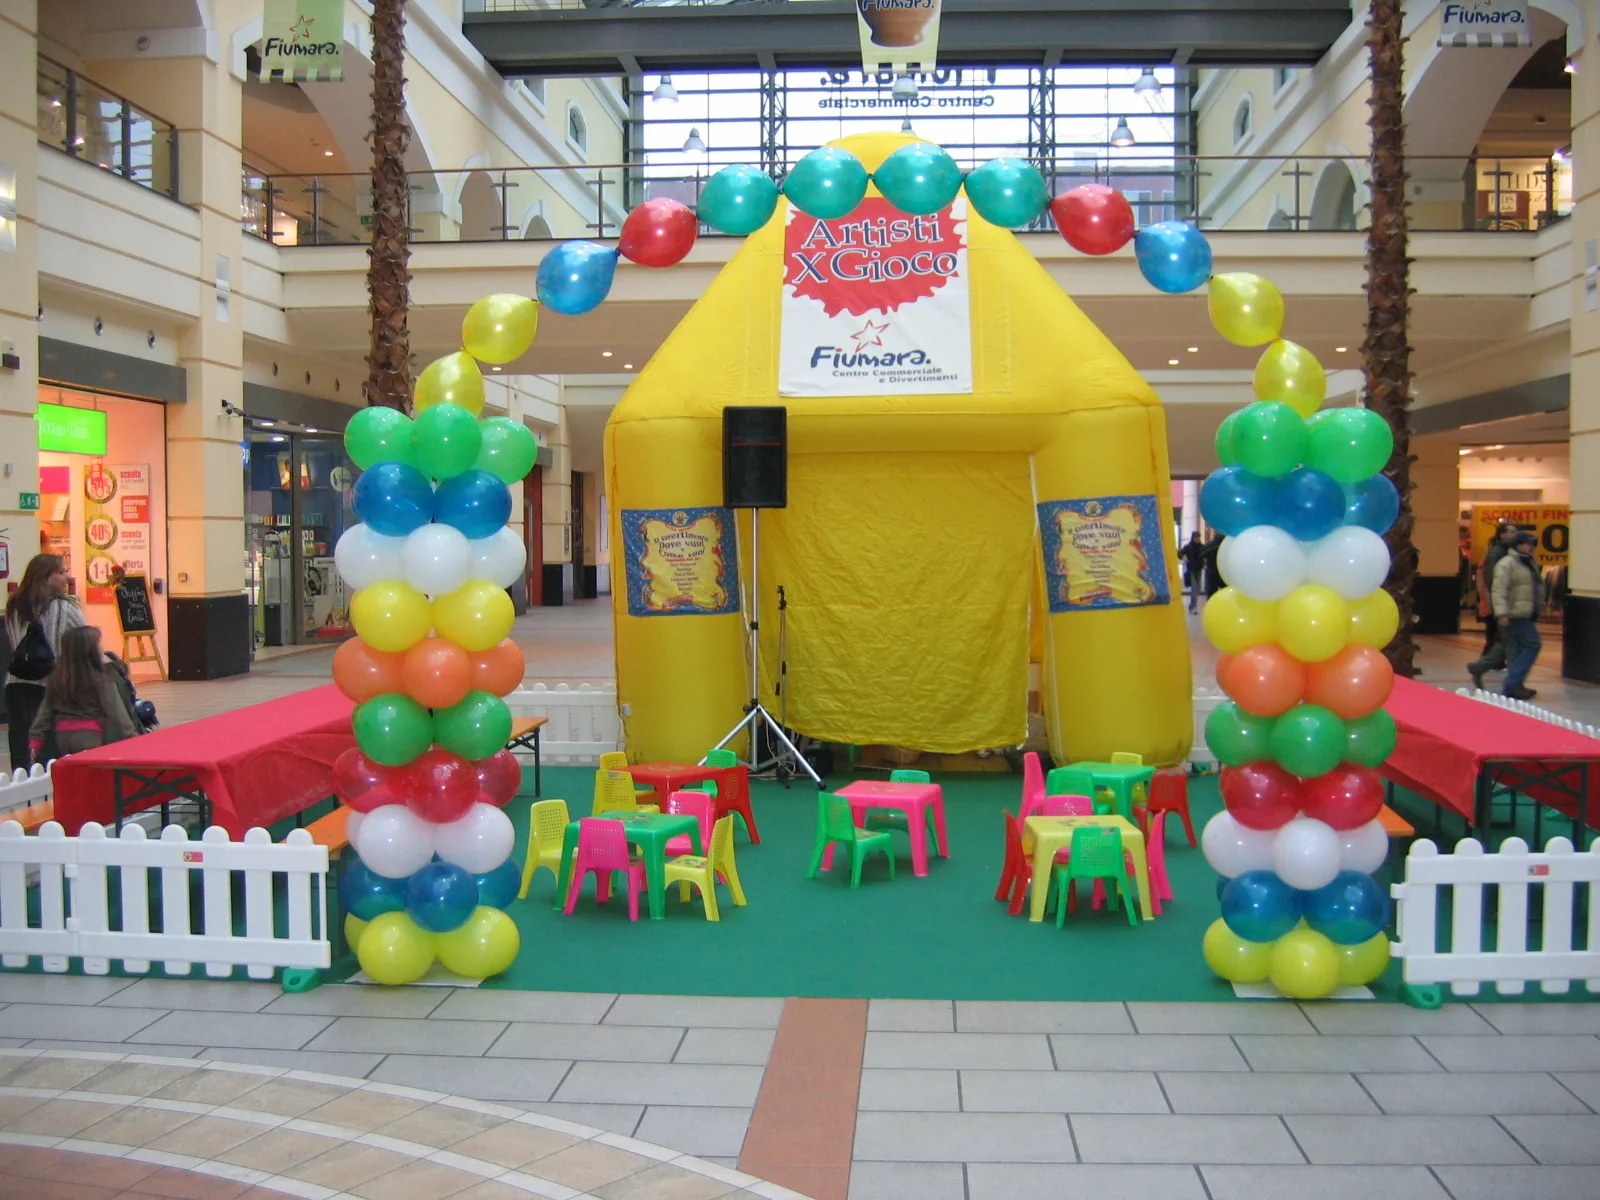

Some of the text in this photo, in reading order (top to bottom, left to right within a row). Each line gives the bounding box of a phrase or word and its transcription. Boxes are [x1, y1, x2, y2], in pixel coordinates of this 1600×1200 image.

[801, 212, 943, 248] Artisti
[872, 367, 943, 377] Commerciale
[889, 374, 958, 384] Divertimenti
